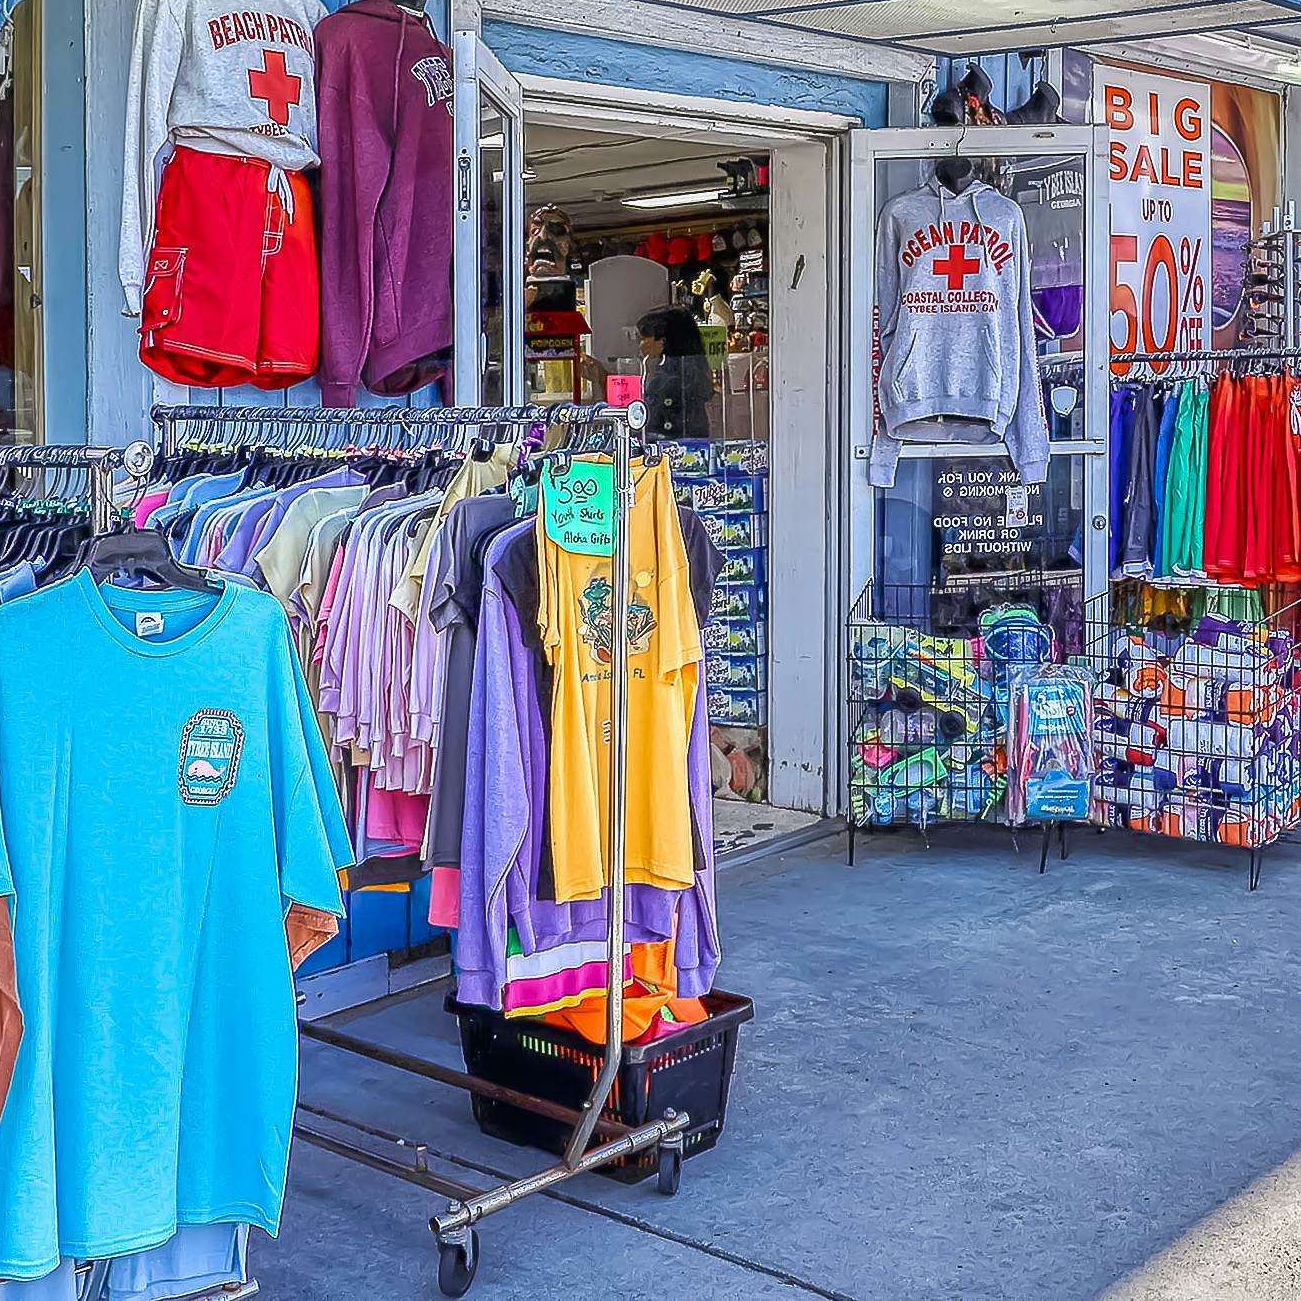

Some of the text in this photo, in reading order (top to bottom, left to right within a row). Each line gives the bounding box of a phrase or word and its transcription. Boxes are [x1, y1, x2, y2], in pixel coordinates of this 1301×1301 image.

[207, 11, 267, 51] BEACH
[1105, 84, 1202, 142] BIG
[1109, 142, 1203, 189] SALE
[1142, 198, 1172, 223] UP TO
[901, 221, 1015, 276] OCEAN PATROL
[907, 304, 938, 314] TYBEE
[1109, 234, 1203, 375] 50%
[633, 668, 646, 679] FL
